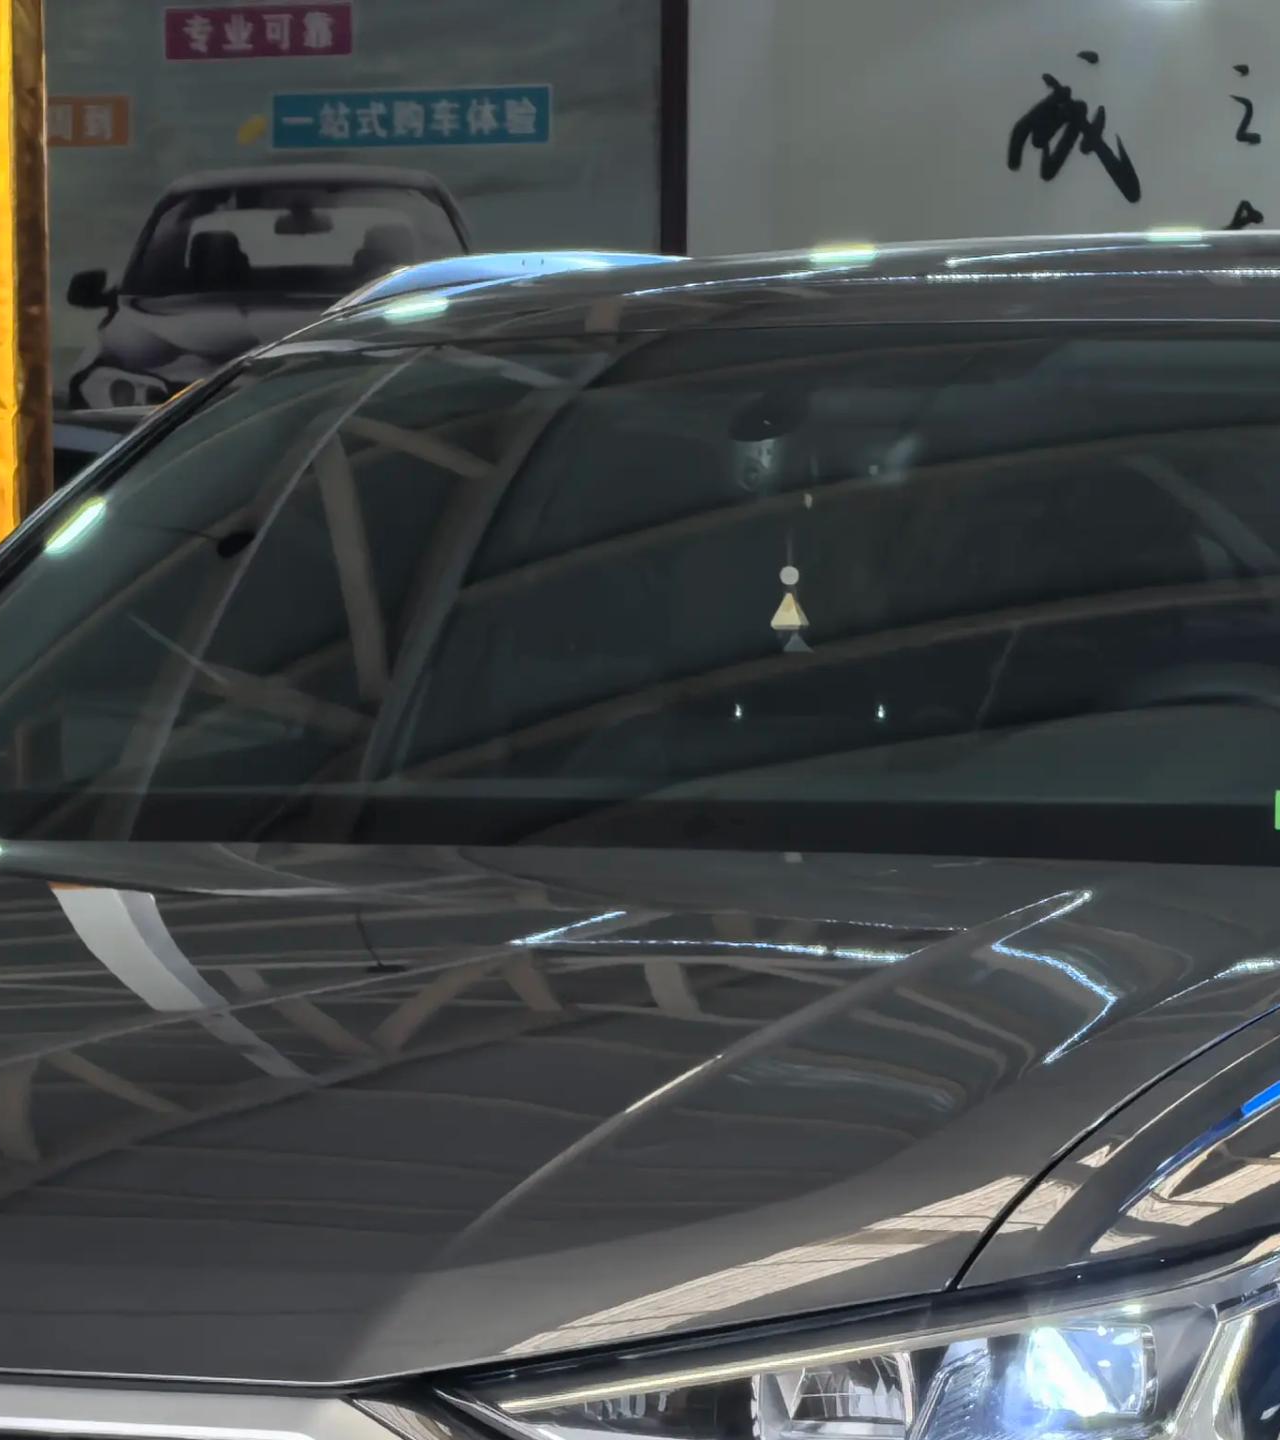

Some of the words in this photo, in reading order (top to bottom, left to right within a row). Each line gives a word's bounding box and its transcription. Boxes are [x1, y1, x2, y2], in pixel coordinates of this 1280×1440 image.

[183, 12, 334, 53] 专业可靠
[282, 98, 538, 139] 一站式购车体验
